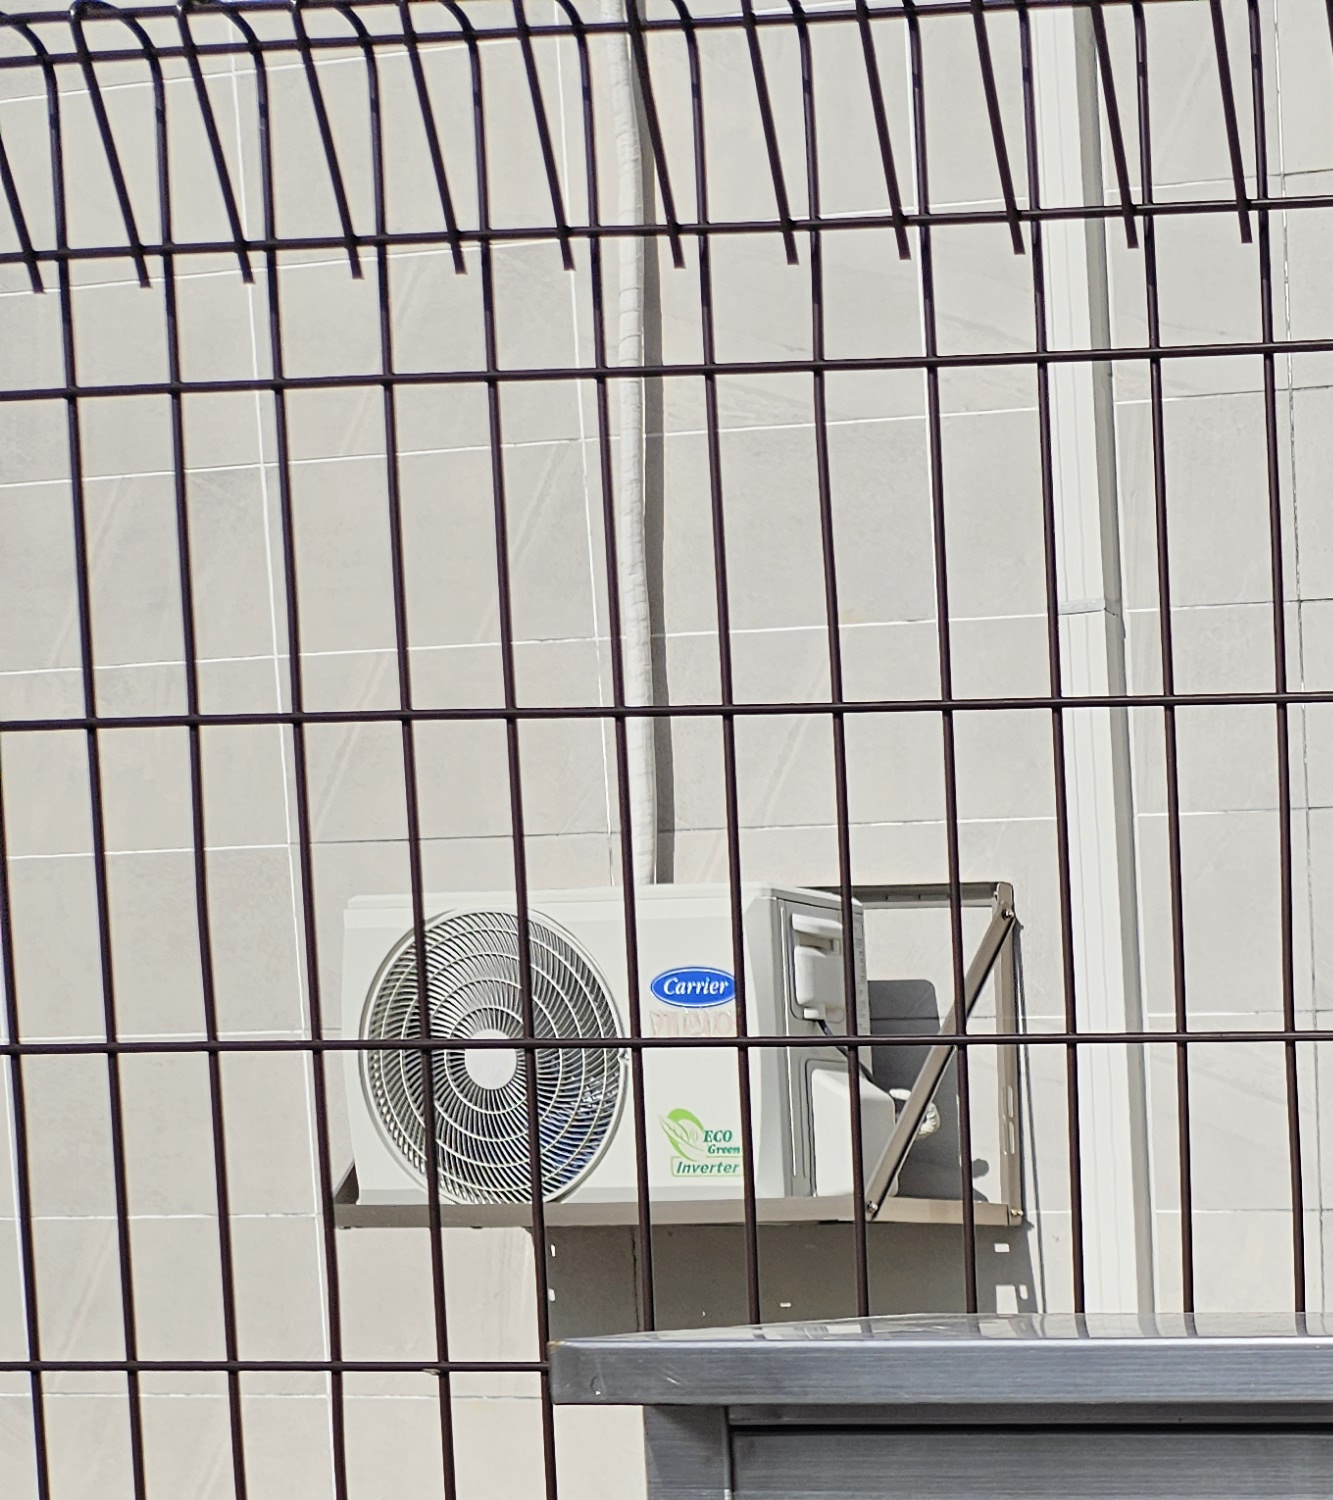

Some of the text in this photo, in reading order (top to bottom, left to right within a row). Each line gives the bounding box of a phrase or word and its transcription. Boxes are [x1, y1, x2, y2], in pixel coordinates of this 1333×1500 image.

[663, 976, 730, 995] Carrier
[703, 1130, 733, 1143] ECO
[707, 1144, 740, 1154] Green
[676, 1161, 740, 1174] Inverter
